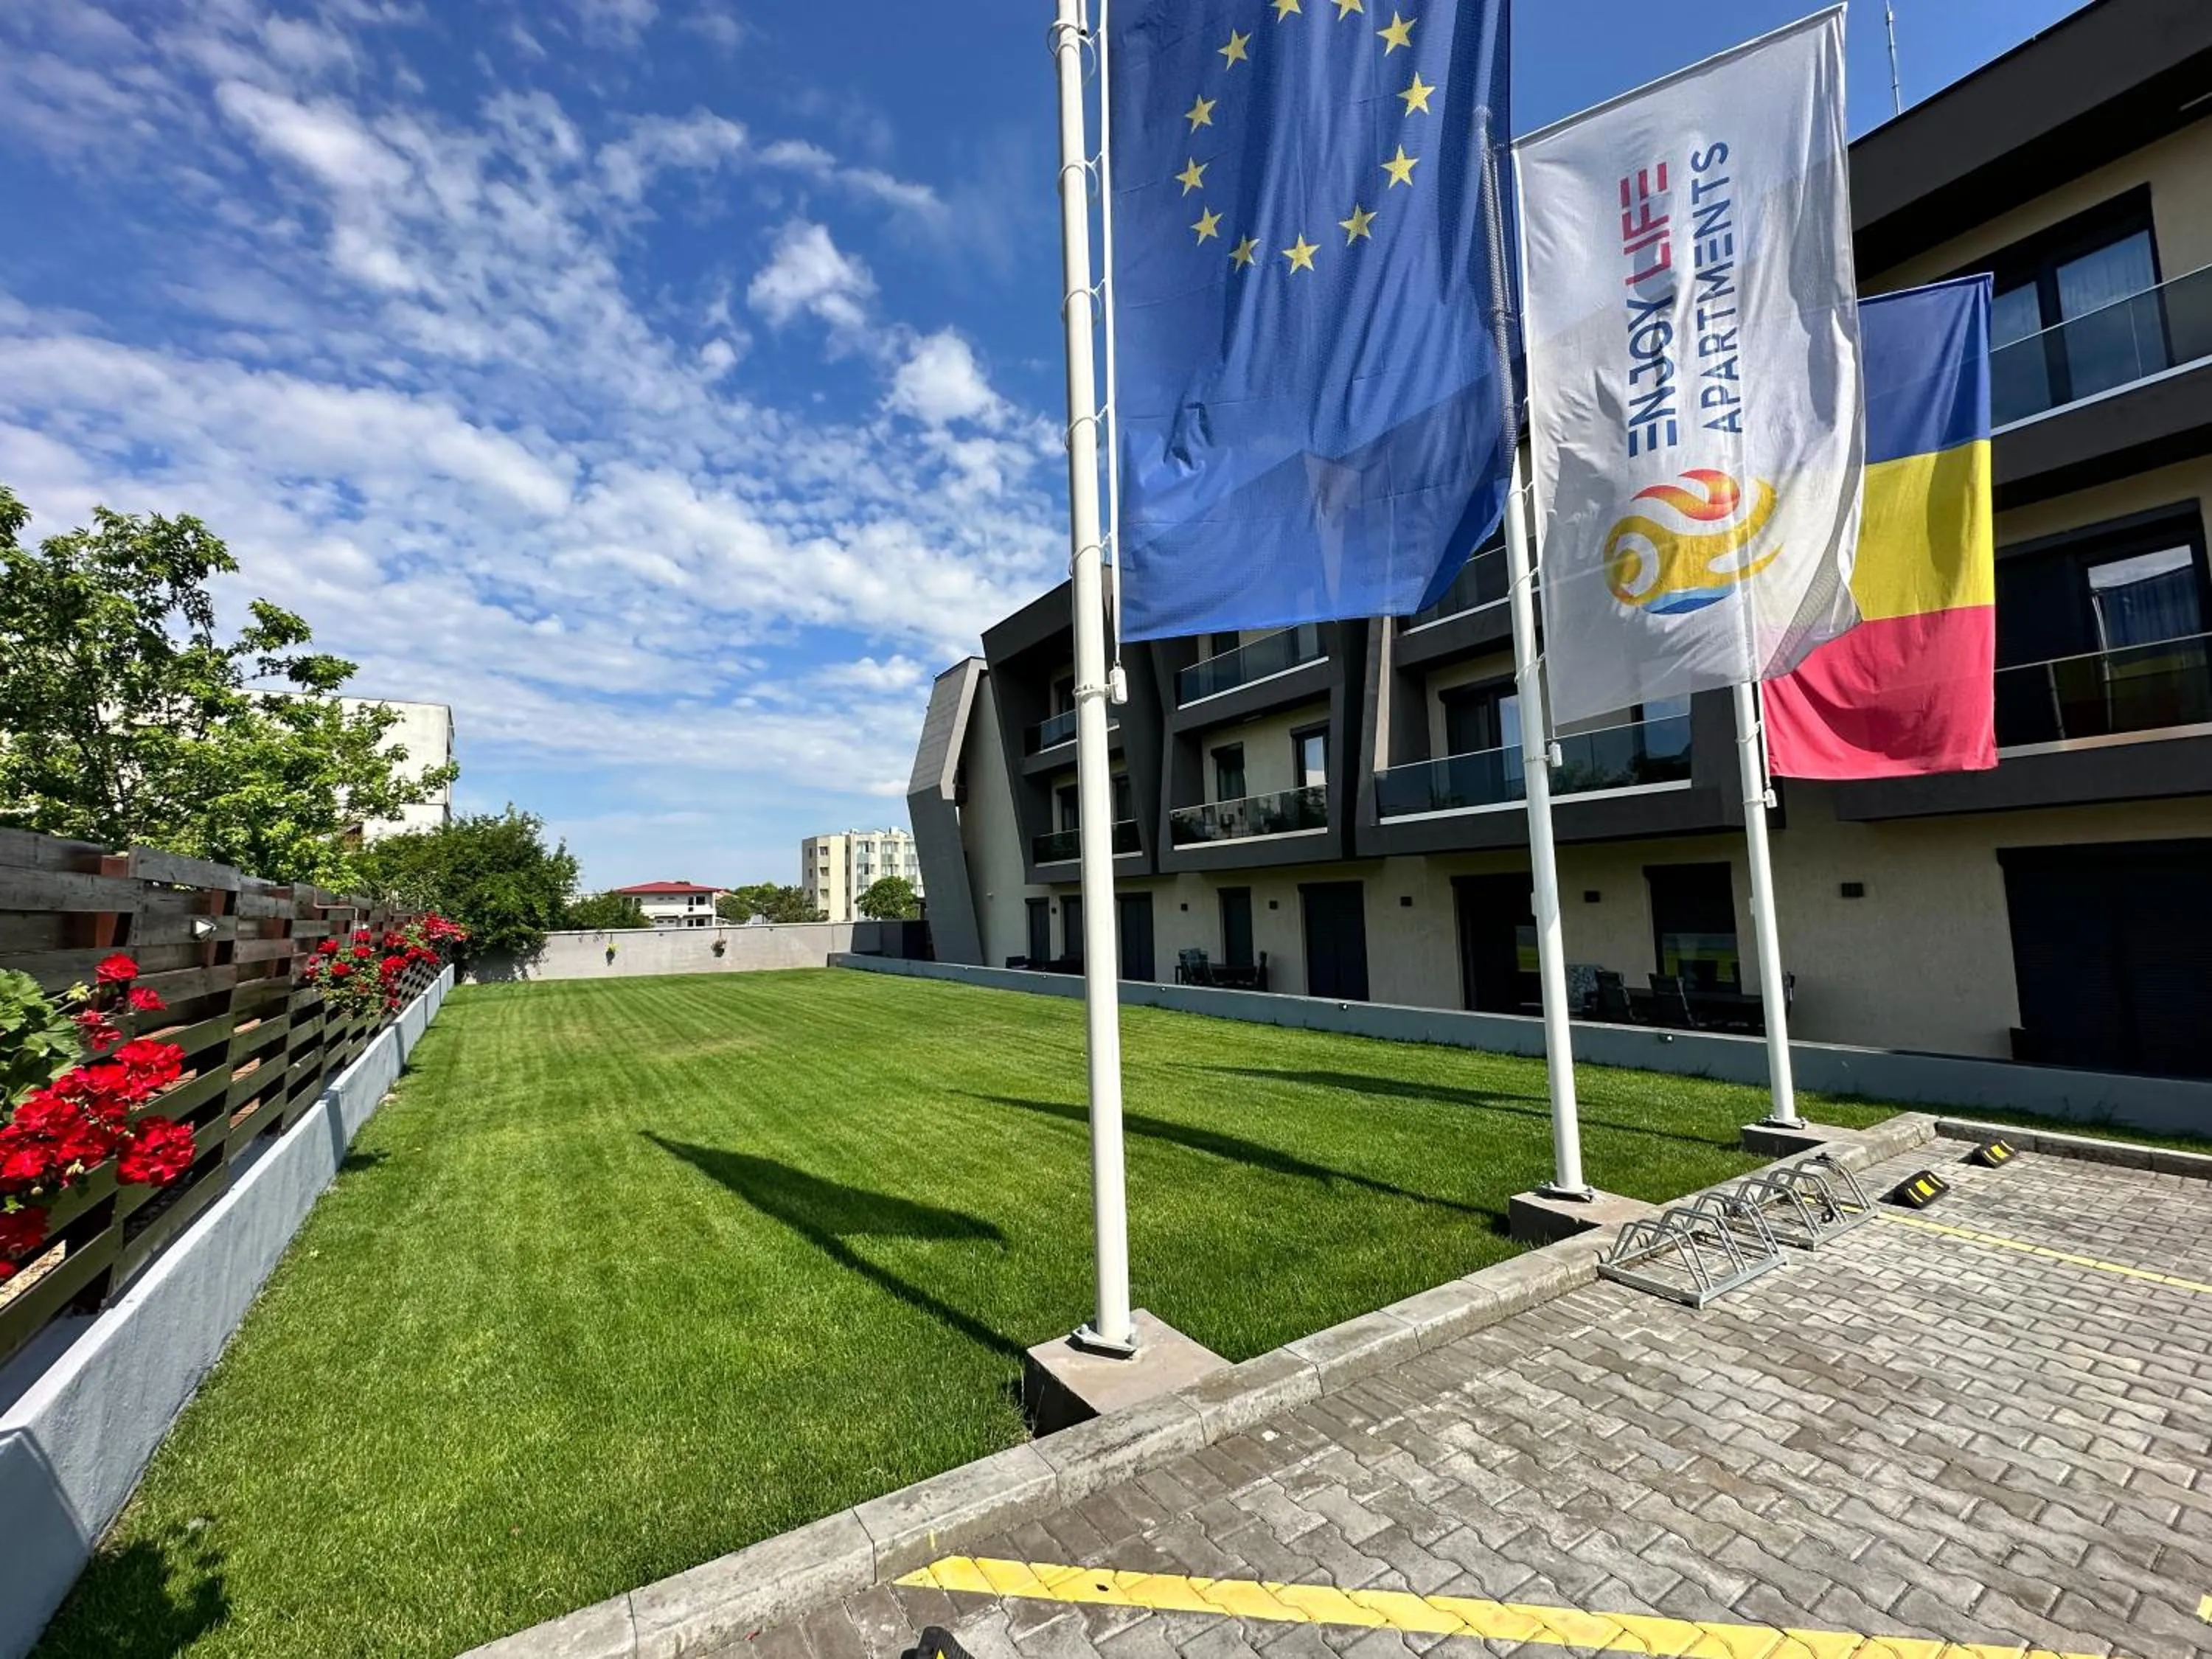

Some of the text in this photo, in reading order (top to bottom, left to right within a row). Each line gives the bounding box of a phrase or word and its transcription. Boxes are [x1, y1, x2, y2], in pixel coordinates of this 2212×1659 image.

[1619, 161, 1677, 458] ENJOY LIFE
[1691, 141, 1742, 434] APARTMENTS
